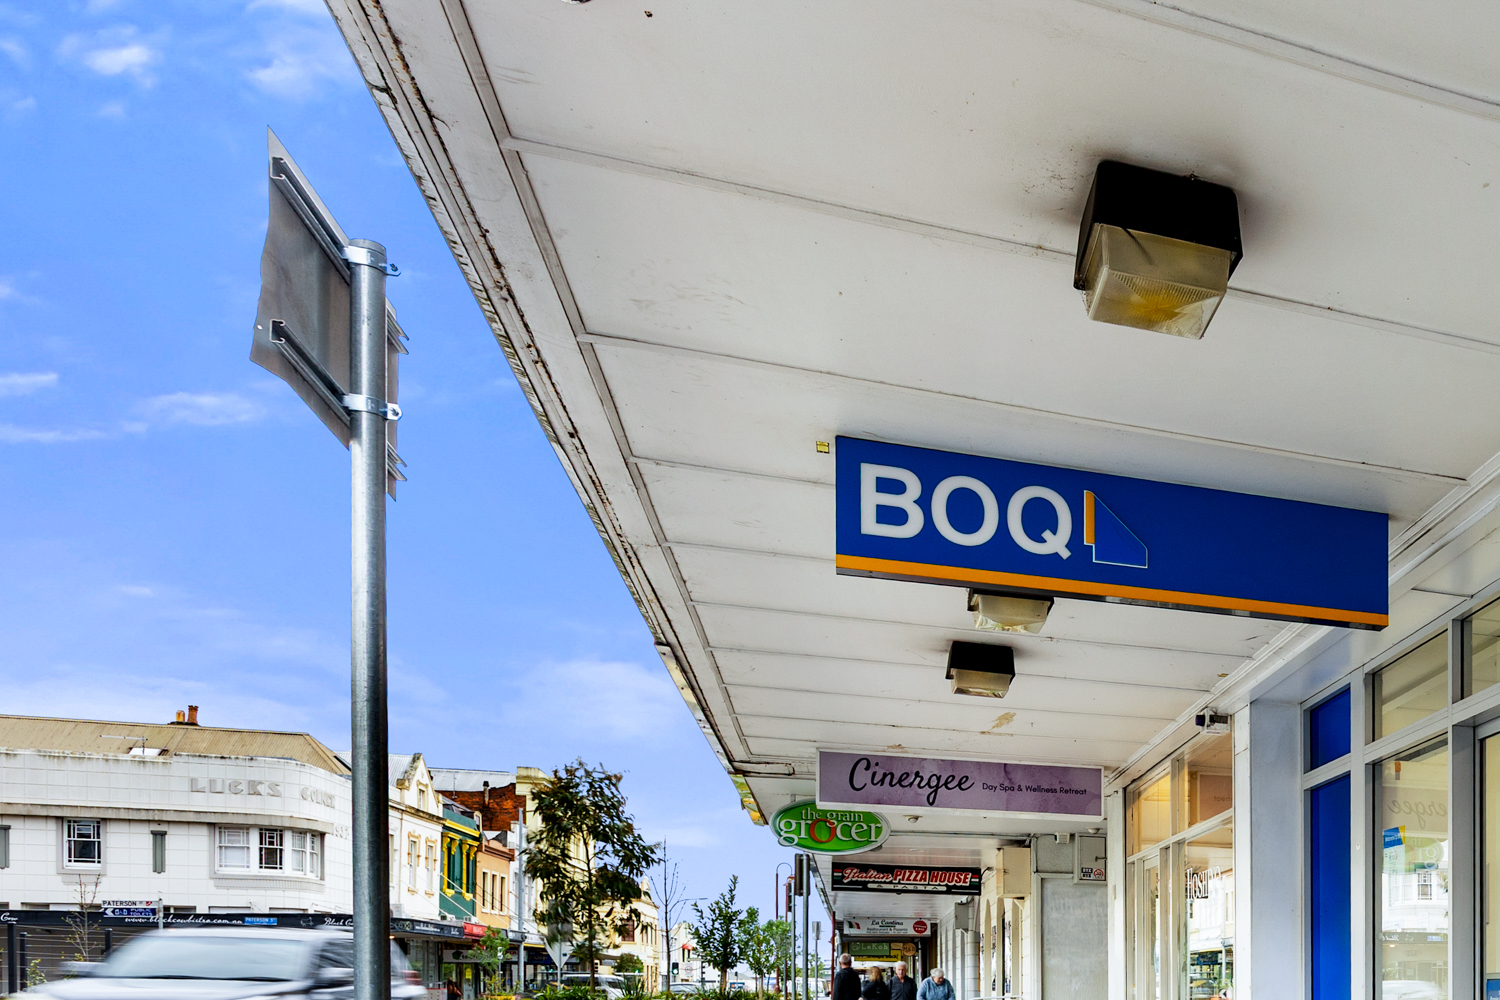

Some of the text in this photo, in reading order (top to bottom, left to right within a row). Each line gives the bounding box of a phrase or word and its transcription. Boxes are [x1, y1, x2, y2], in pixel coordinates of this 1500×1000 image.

[860, 463, 1072, 559] BOQ
[849, 758, 975, 806] Cinergee
[982, 782, 997, 792] Day
[1000, 784, 1014, 793] Spa
[1026, 785, 1057, 793] Wellness
[1060, 786, 1087, 795] Retreat
[801, 807, 863, 827] the grain
[780, 819, 881, 846] grocer
[843, 867, 971, 886] Italian PIZZA HOUSE
[125, 915, 243, 923] www.blckcowbistro.com.au
